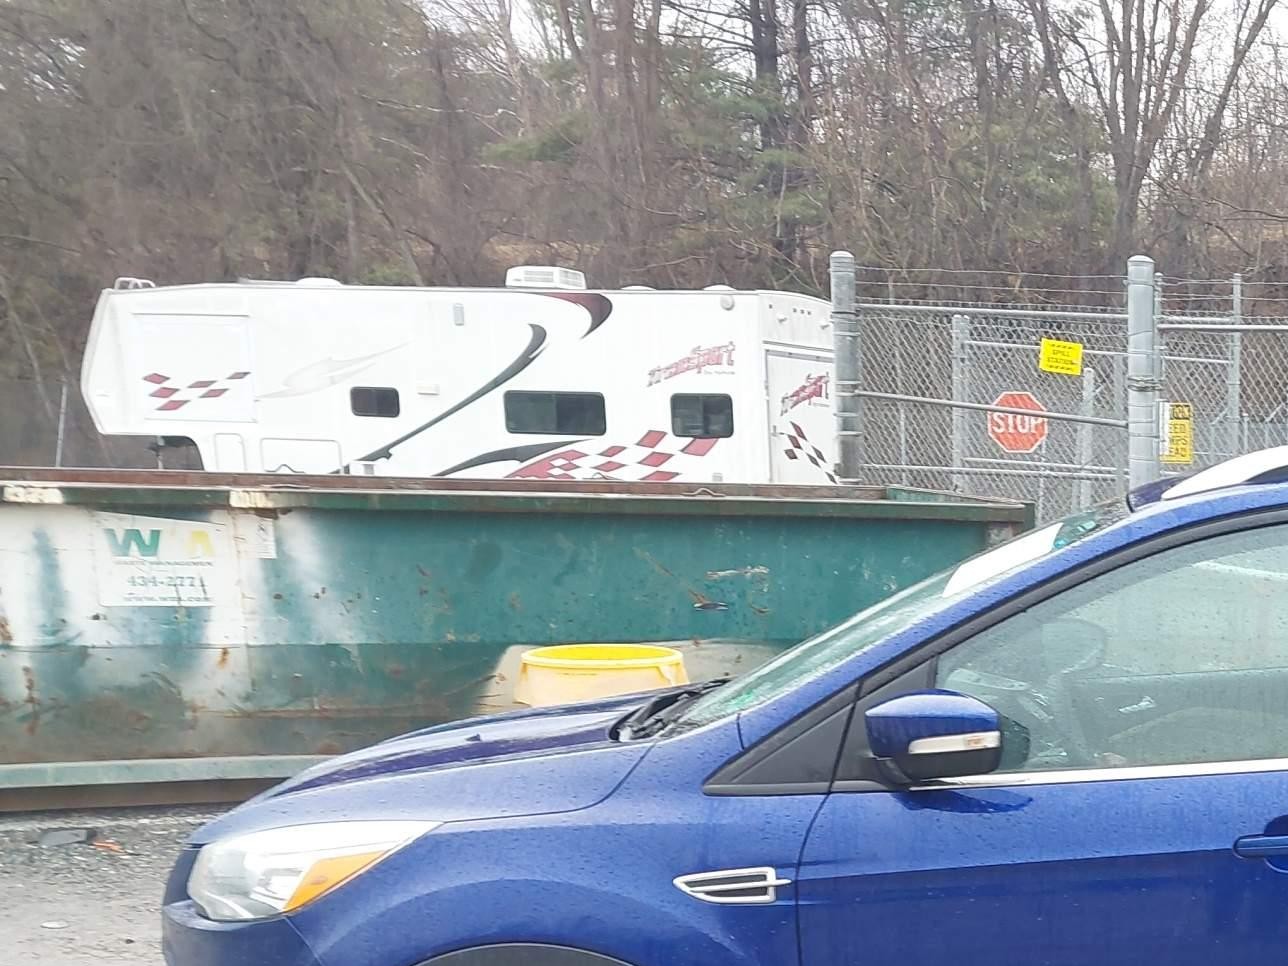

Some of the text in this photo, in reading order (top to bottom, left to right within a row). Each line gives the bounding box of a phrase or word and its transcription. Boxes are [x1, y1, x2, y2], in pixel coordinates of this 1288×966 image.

[991, 412, 1043, 433] STOP
[1169, 423, 1186, 433] EED
[1169, 435, 1188, 446] MPS
[1169, 447, 1188, 457] EAD
